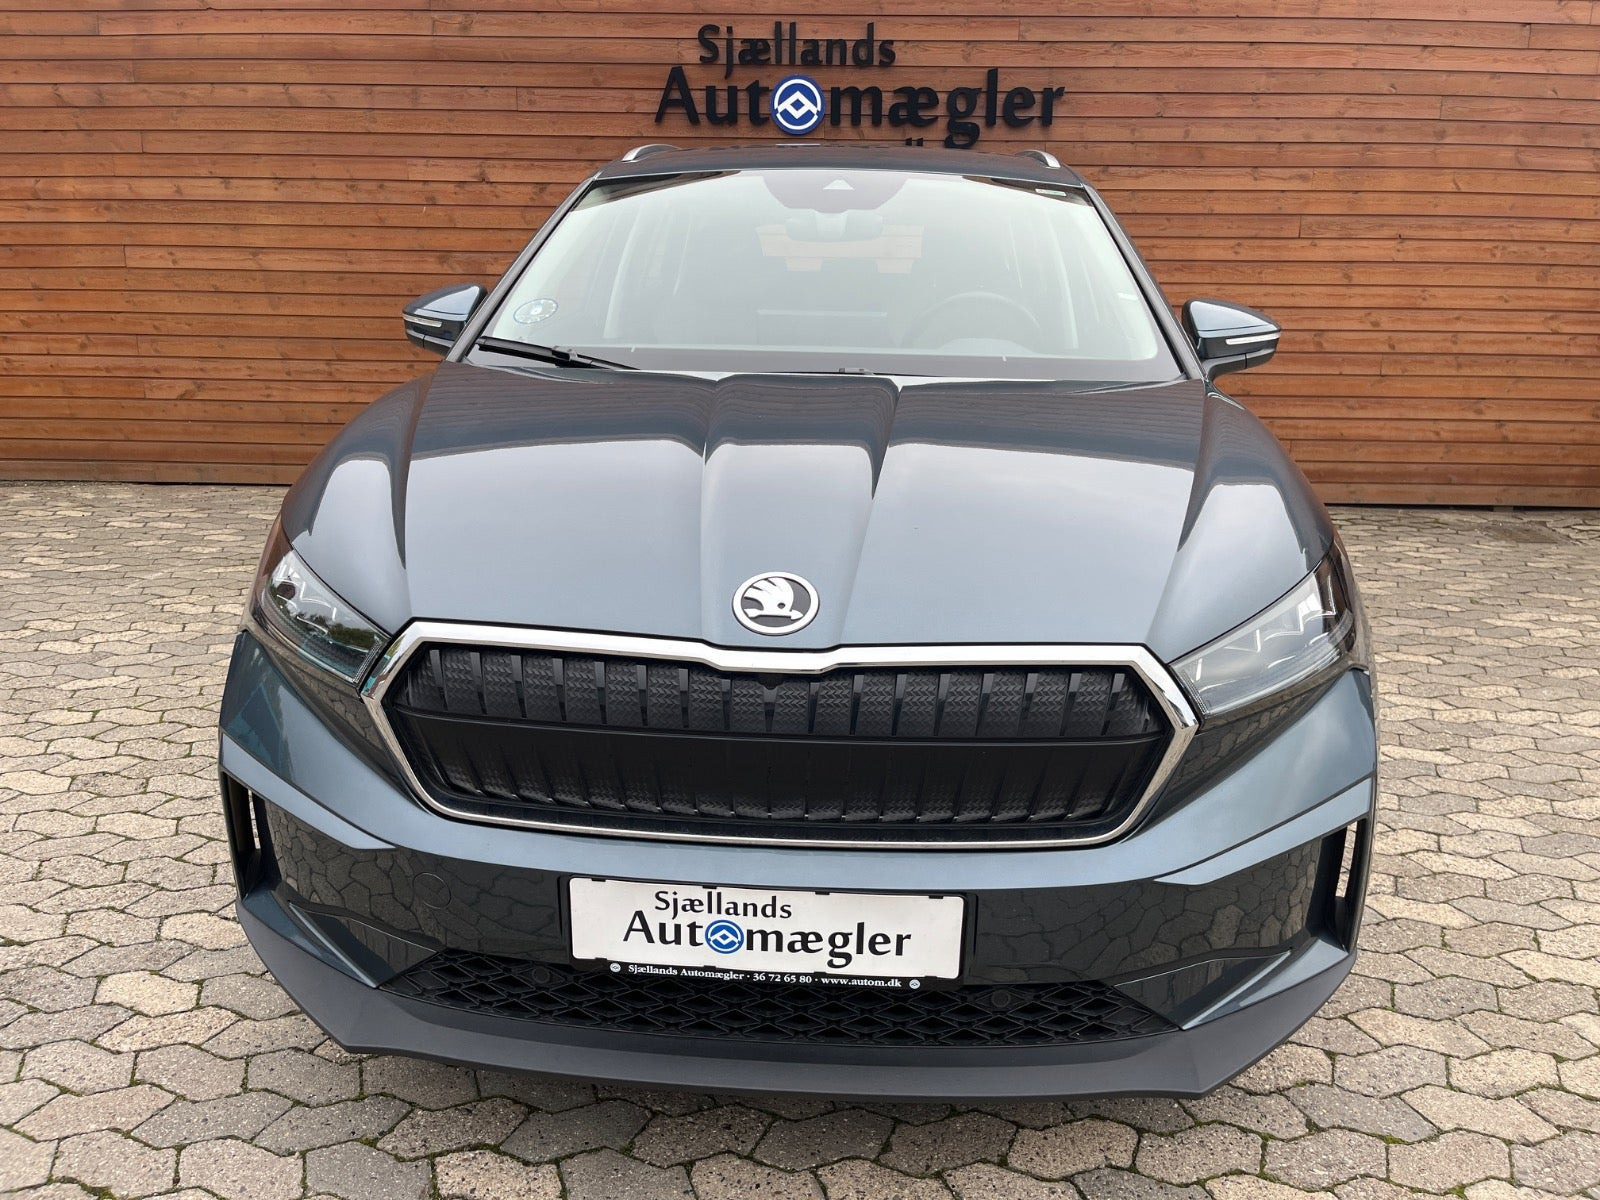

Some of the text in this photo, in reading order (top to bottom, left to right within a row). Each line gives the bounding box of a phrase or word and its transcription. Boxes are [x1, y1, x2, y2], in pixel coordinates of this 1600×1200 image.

[697, 21, 897, 79] Sjællands
[654, 66, 1066, 149] Automægler
[654, 890, 793, 920] Sjællands
[622, 910, 912, 969] Automægler
[628, 965, 902, 987] Sjællands Automægler 36 72 65 80 www.autom.dk
